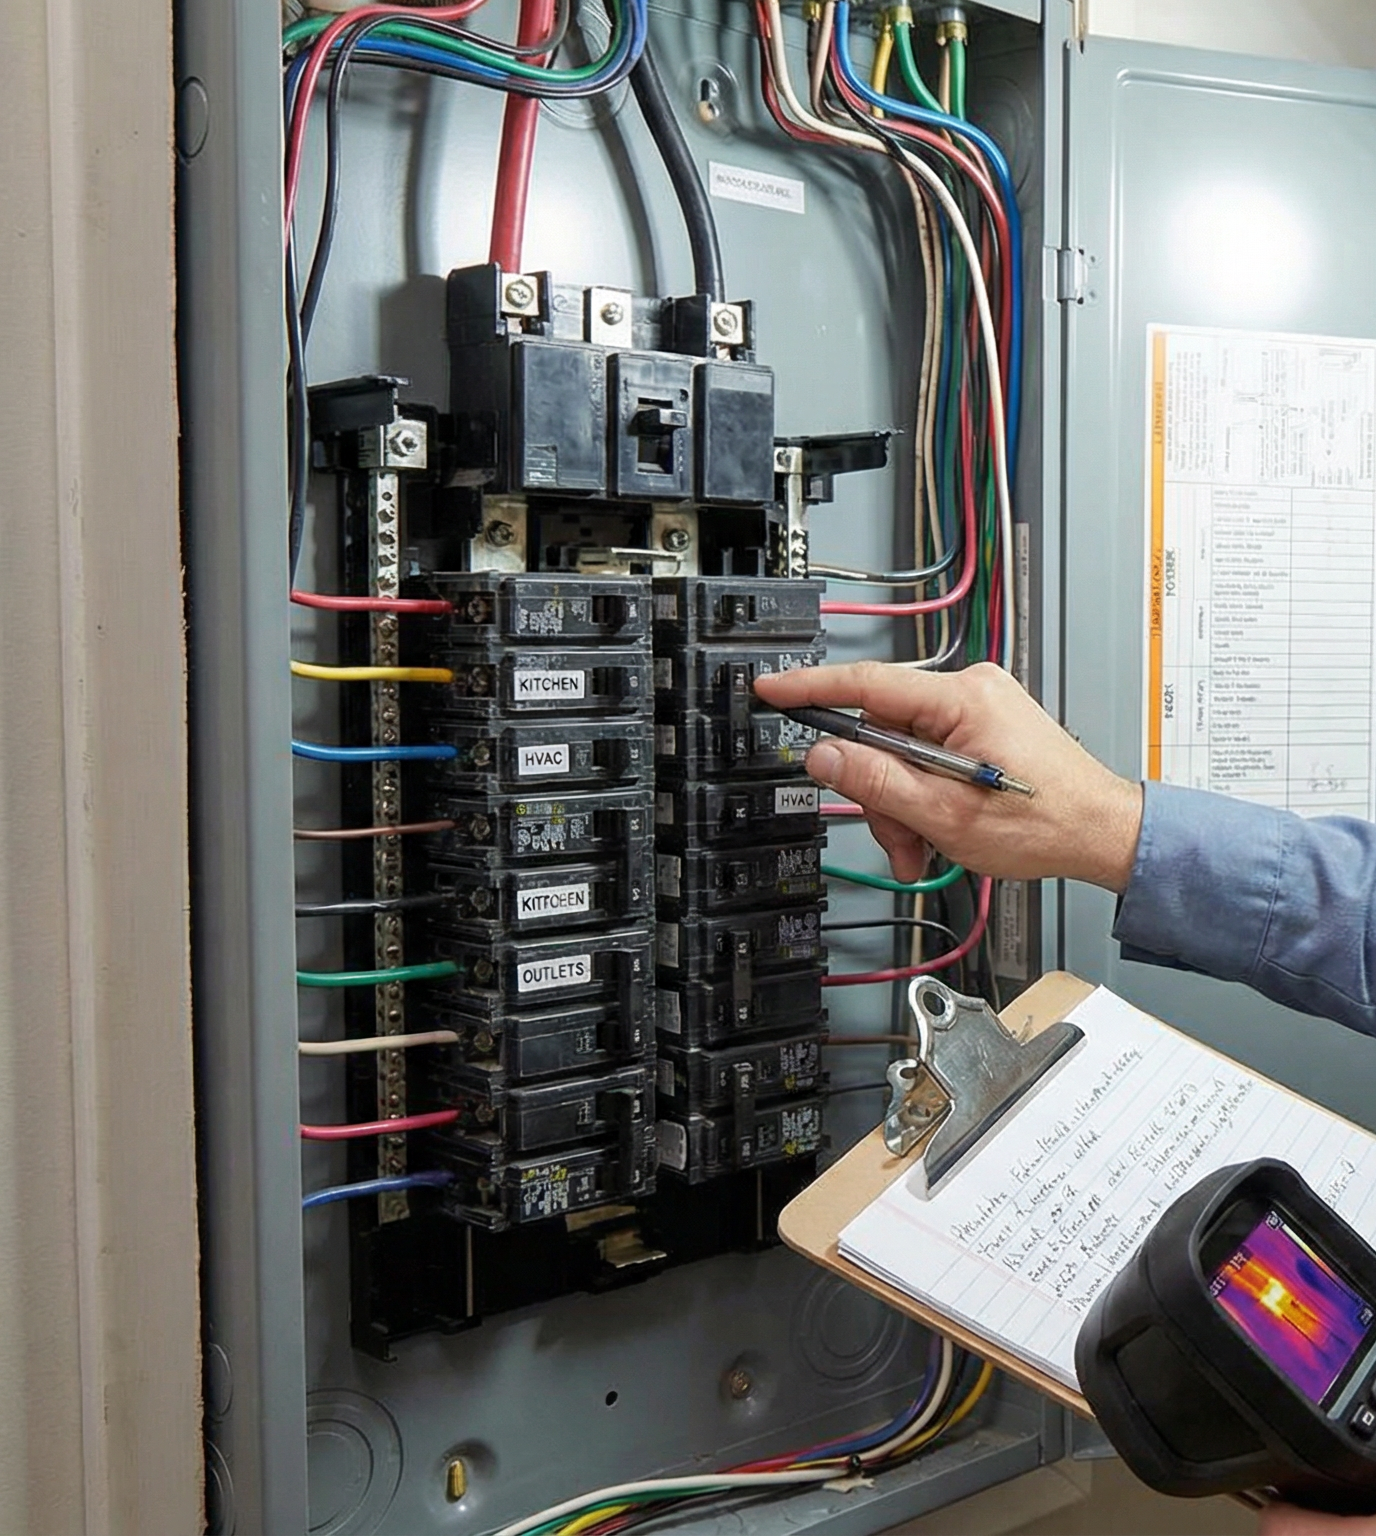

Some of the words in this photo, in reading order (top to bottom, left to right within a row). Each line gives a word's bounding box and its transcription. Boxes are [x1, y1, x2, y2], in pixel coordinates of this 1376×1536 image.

[519, 677, 579, 692] KITCHEN
[525, 750, 563, 767] HVAC
[781, 793, 814, 807] HVAC
[522, 961, 585, 984] OUTLETS
